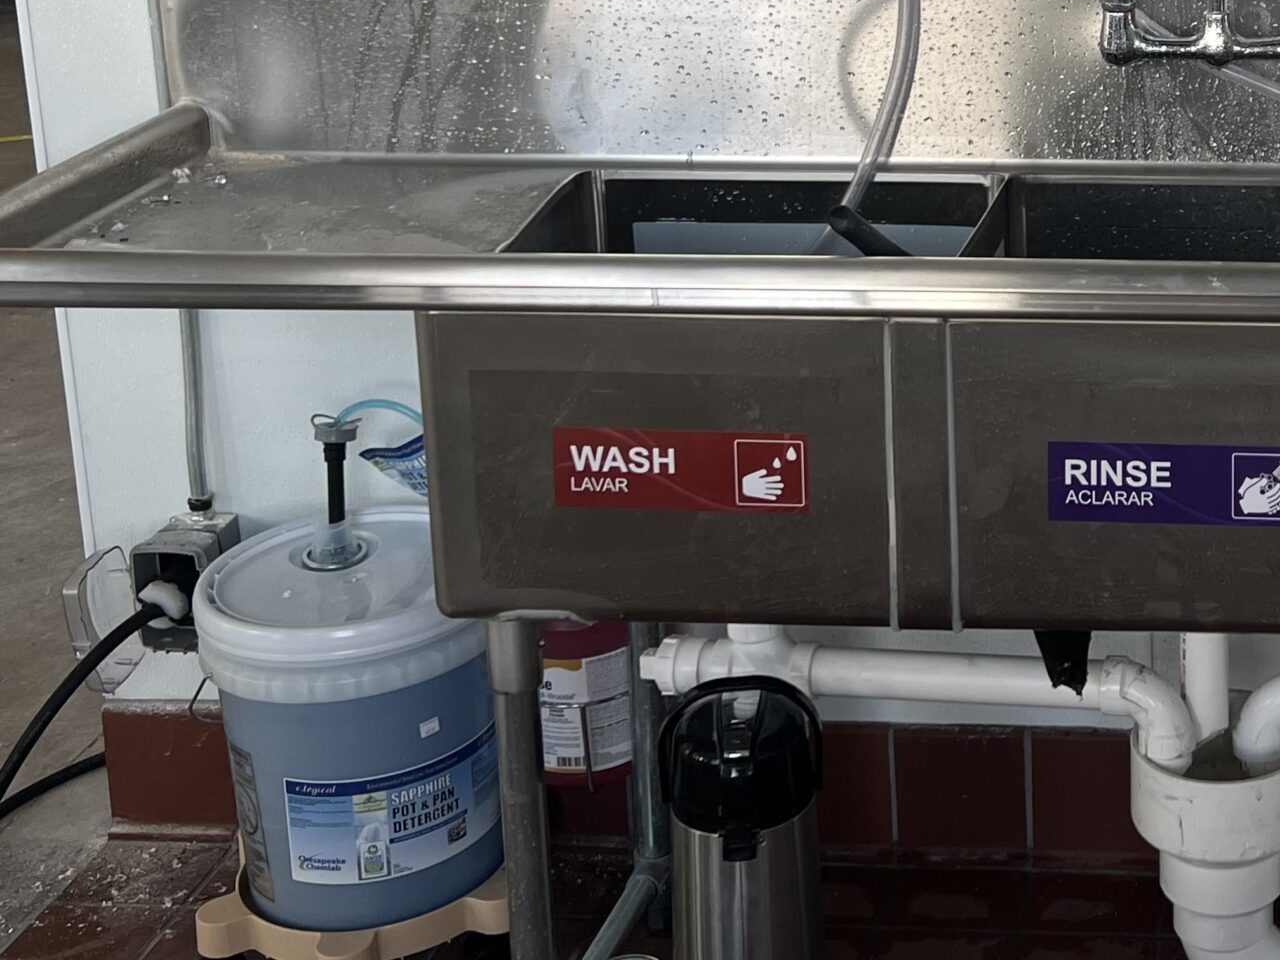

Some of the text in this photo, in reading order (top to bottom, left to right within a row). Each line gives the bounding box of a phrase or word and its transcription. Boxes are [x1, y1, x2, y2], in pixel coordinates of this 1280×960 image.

[570, 445, 676, 474] WASH
[1064, 458, 1172, 488] RINSE
[570, 476, 628, 492] LAVAR
[1065, 490, 1154, 506] ACLARAR
[391, 774, 451, 805] SAPPHIRE
[392, 786, 455, 819] POT & PAN
[394, 798, 460, 833] DETERGENT
